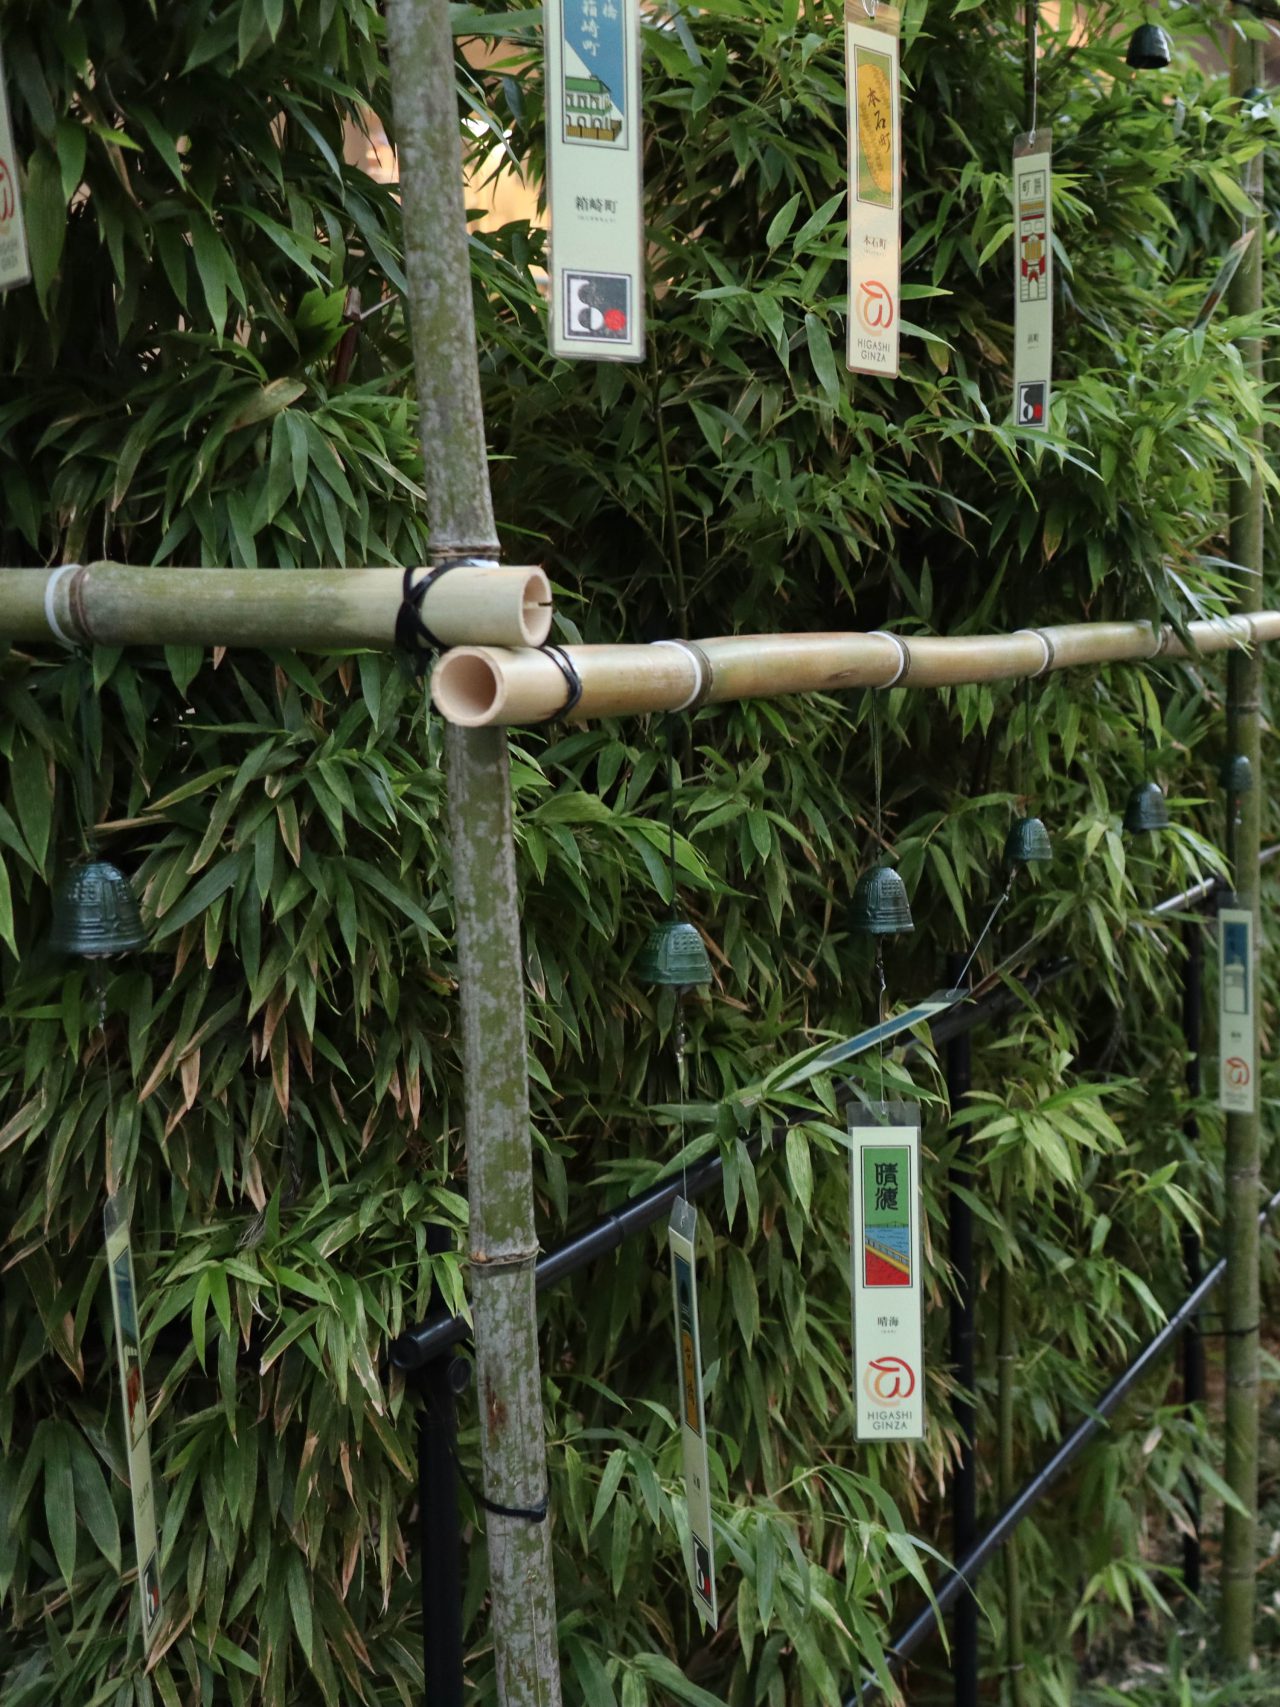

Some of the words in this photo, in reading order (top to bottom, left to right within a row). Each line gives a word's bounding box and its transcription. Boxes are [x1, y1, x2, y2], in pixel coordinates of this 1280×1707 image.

[867, 88, 891, 152] 本石町
[575, 195, 617, 214] 箱崎町
[857, 338, 891, 353] HIGASHI
[861, 350, 887, 363] GINZA
[874, 1163, 898, 1211] 晴海
[877, 1316, 899, 1328] 晴海
[867, 1410, 913, 1421] HIGASHI
[872, 1421, 908, 1431] GINZA
